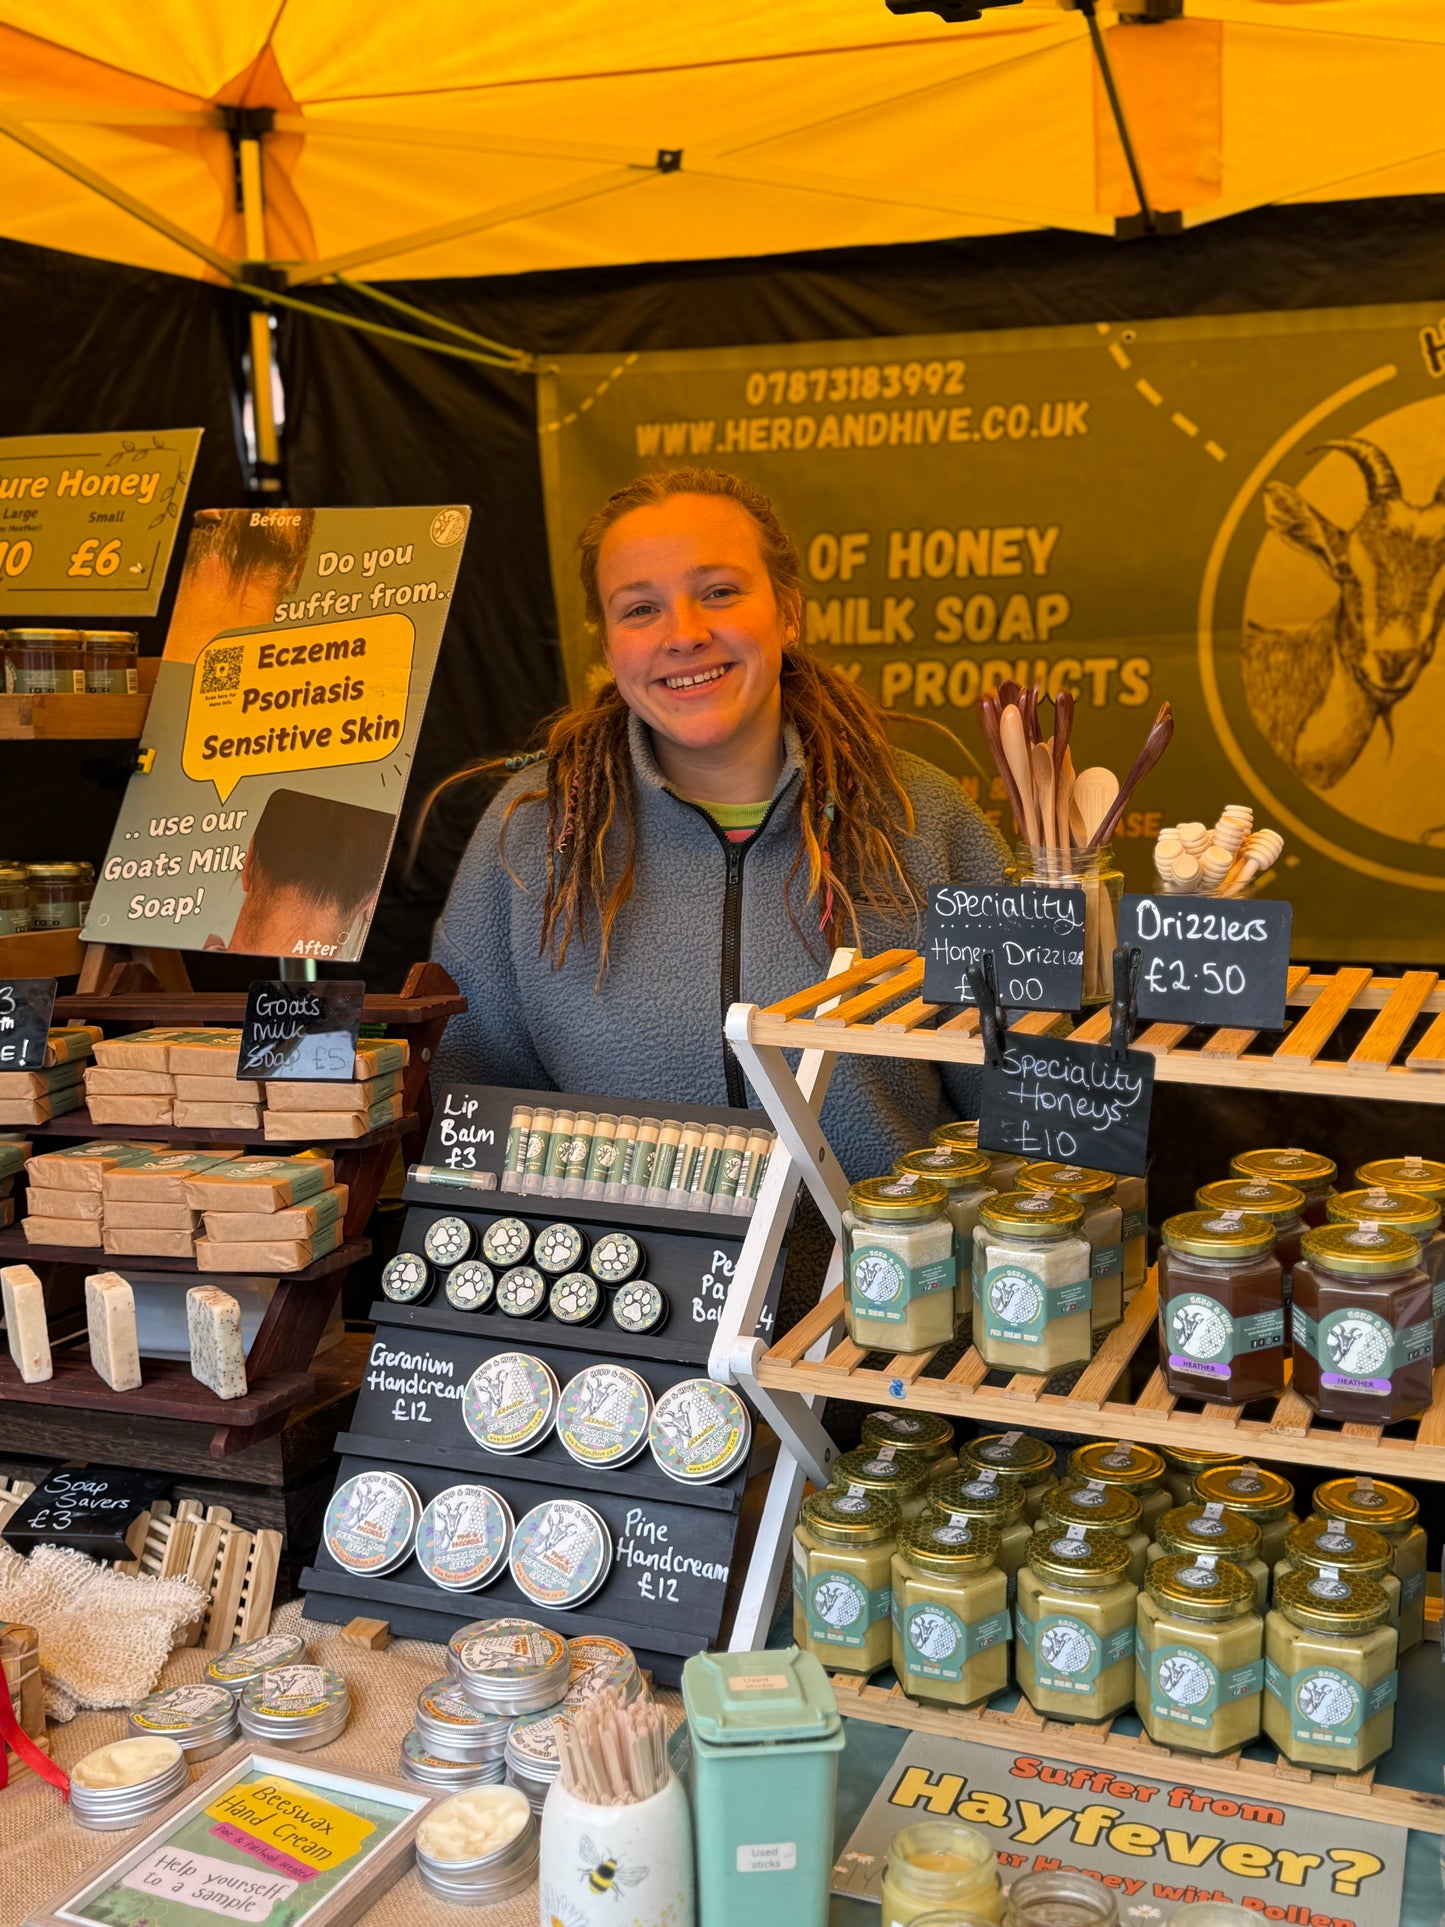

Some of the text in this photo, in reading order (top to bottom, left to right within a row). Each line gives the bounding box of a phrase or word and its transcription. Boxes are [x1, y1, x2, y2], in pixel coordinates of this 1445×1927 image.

[746, 360, 967, 406] 07873183992
[634, 401, 1091, 458] WWW.HERDANDHIVE.CO.UK
[0, 469, 160, 504] ure Honey
[3, 508, 39, 522] Large
[88, 510, 126, 523] Small
[249, 512, 302, 528] Before
[67, 538, 122, 577] £6
[318, 544, 414, 579] Do you
[807, 526, 1059, 583] OF HONEY
[274, 589, 363, 624] suffer
[805, 593, 1071, 646] MILK SOAP
[258, 635, 367, 670] Eczema
[242, 676, 365, 715] Psoriasis
[883, 657, 1152, 708] PRODUCTS
[202, 715, 400, 762] Sensitive Skin
[149, 812, 195, 838] use
[201, 809, 248, 834] our
[104, 845, 246, 882] Goats Milk
[128, 888, 205, 924] Soap!
[935, 888, 1084, 936] Speciality
[1136, 900, 1269, 942] Drizzlers
[292, 939, 338, 958] After
[931, 937, 994, 966] Hone
[256, 993, 321, 1016] Goats
[954, 973, 1044, 1001] £.00
[312, 1046, 347, 1071] £5
[1001, 1048, 1142, 1107] Speciality
[445, 1093, 479, 1119] Lip
[1007, 1081, 1122, 1131] Honeys
[440, 1119, 495, 1146] Balm
[1013, 1120, 1077, 1157] £10
[446, 1147, 477, 1169] £3
[711, 1249, 736, 1277] Pe
[702, 1274, 730, 1300] Pa
[692, 1297, 774, 1332] Bal 4
[370, 1342, 454, 1377] Geranium
[1183, 1360, 1216, 1373] HEATHER
[1337, 1377, 1374, 1388] HEATHER
[391, 1398, 432, 1423] £12
[44, 1473, 109, 1496] Soap
[55, 1491, 130, 1509] Savers
[28, 1509, 72, 1530] £3
[625, 1508, 668, 1542] Pine
[616, 1538, 728, 1583] Handcream
[637, 1576, 680, 1602] £12
[1009, 1756, 1285, 1826] Suffer from
[215, 1794, 332, 1862] Hand Cream
[251, 1785, 334, 1836] Beeswax
[889, 1764, 1386, 1898] Hayfever?
[750, 1858, 781, 1870] sticks
[751, 1847, 779, 1858] Used
[995, 1850, 1028, 1868] ur
[143, 1871, 257, 1913] to a sample
[153, 1854, 290, 1901] Help yourself
